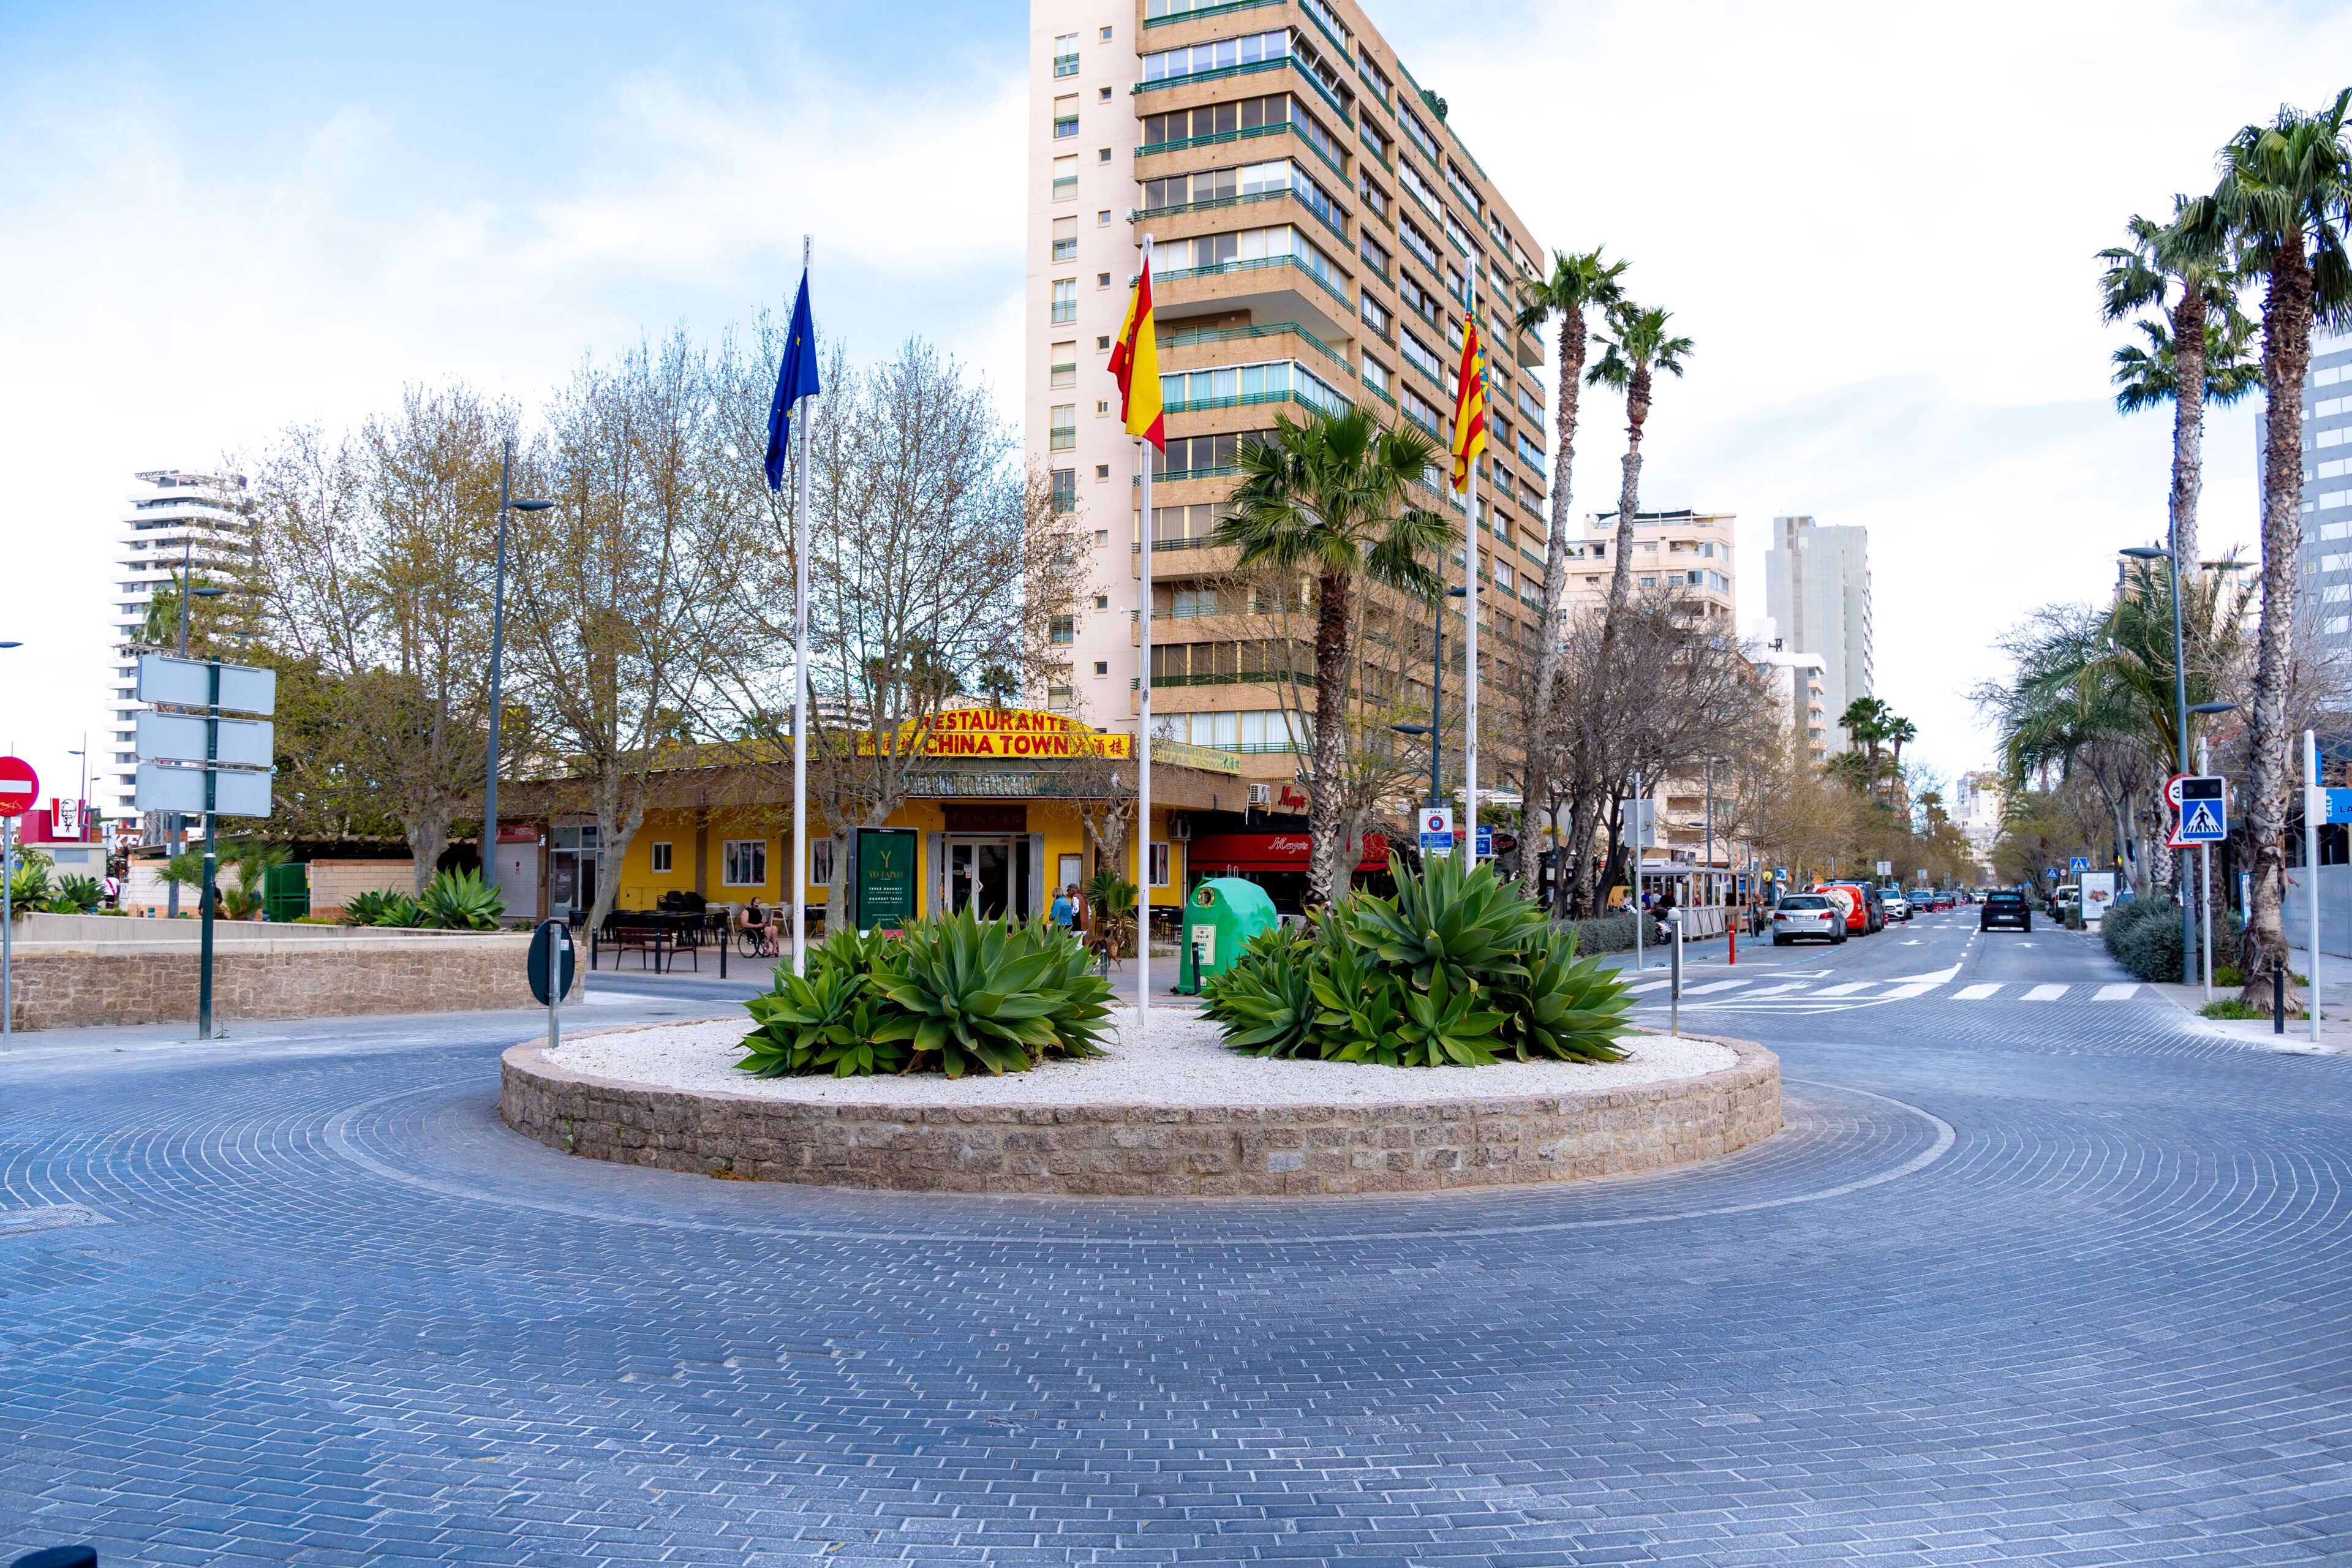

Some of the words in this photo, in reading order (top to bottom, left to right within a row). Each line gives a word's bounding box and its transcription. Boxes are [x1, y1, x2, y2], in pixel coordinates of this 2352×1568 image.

[919, 709, 1069, 731] RESTAURANTE
[924, 734, 994, 753] CHINA
[1000, 735, 1069, 755] TOWN
[514, 827, 535, 835] POSTAL
